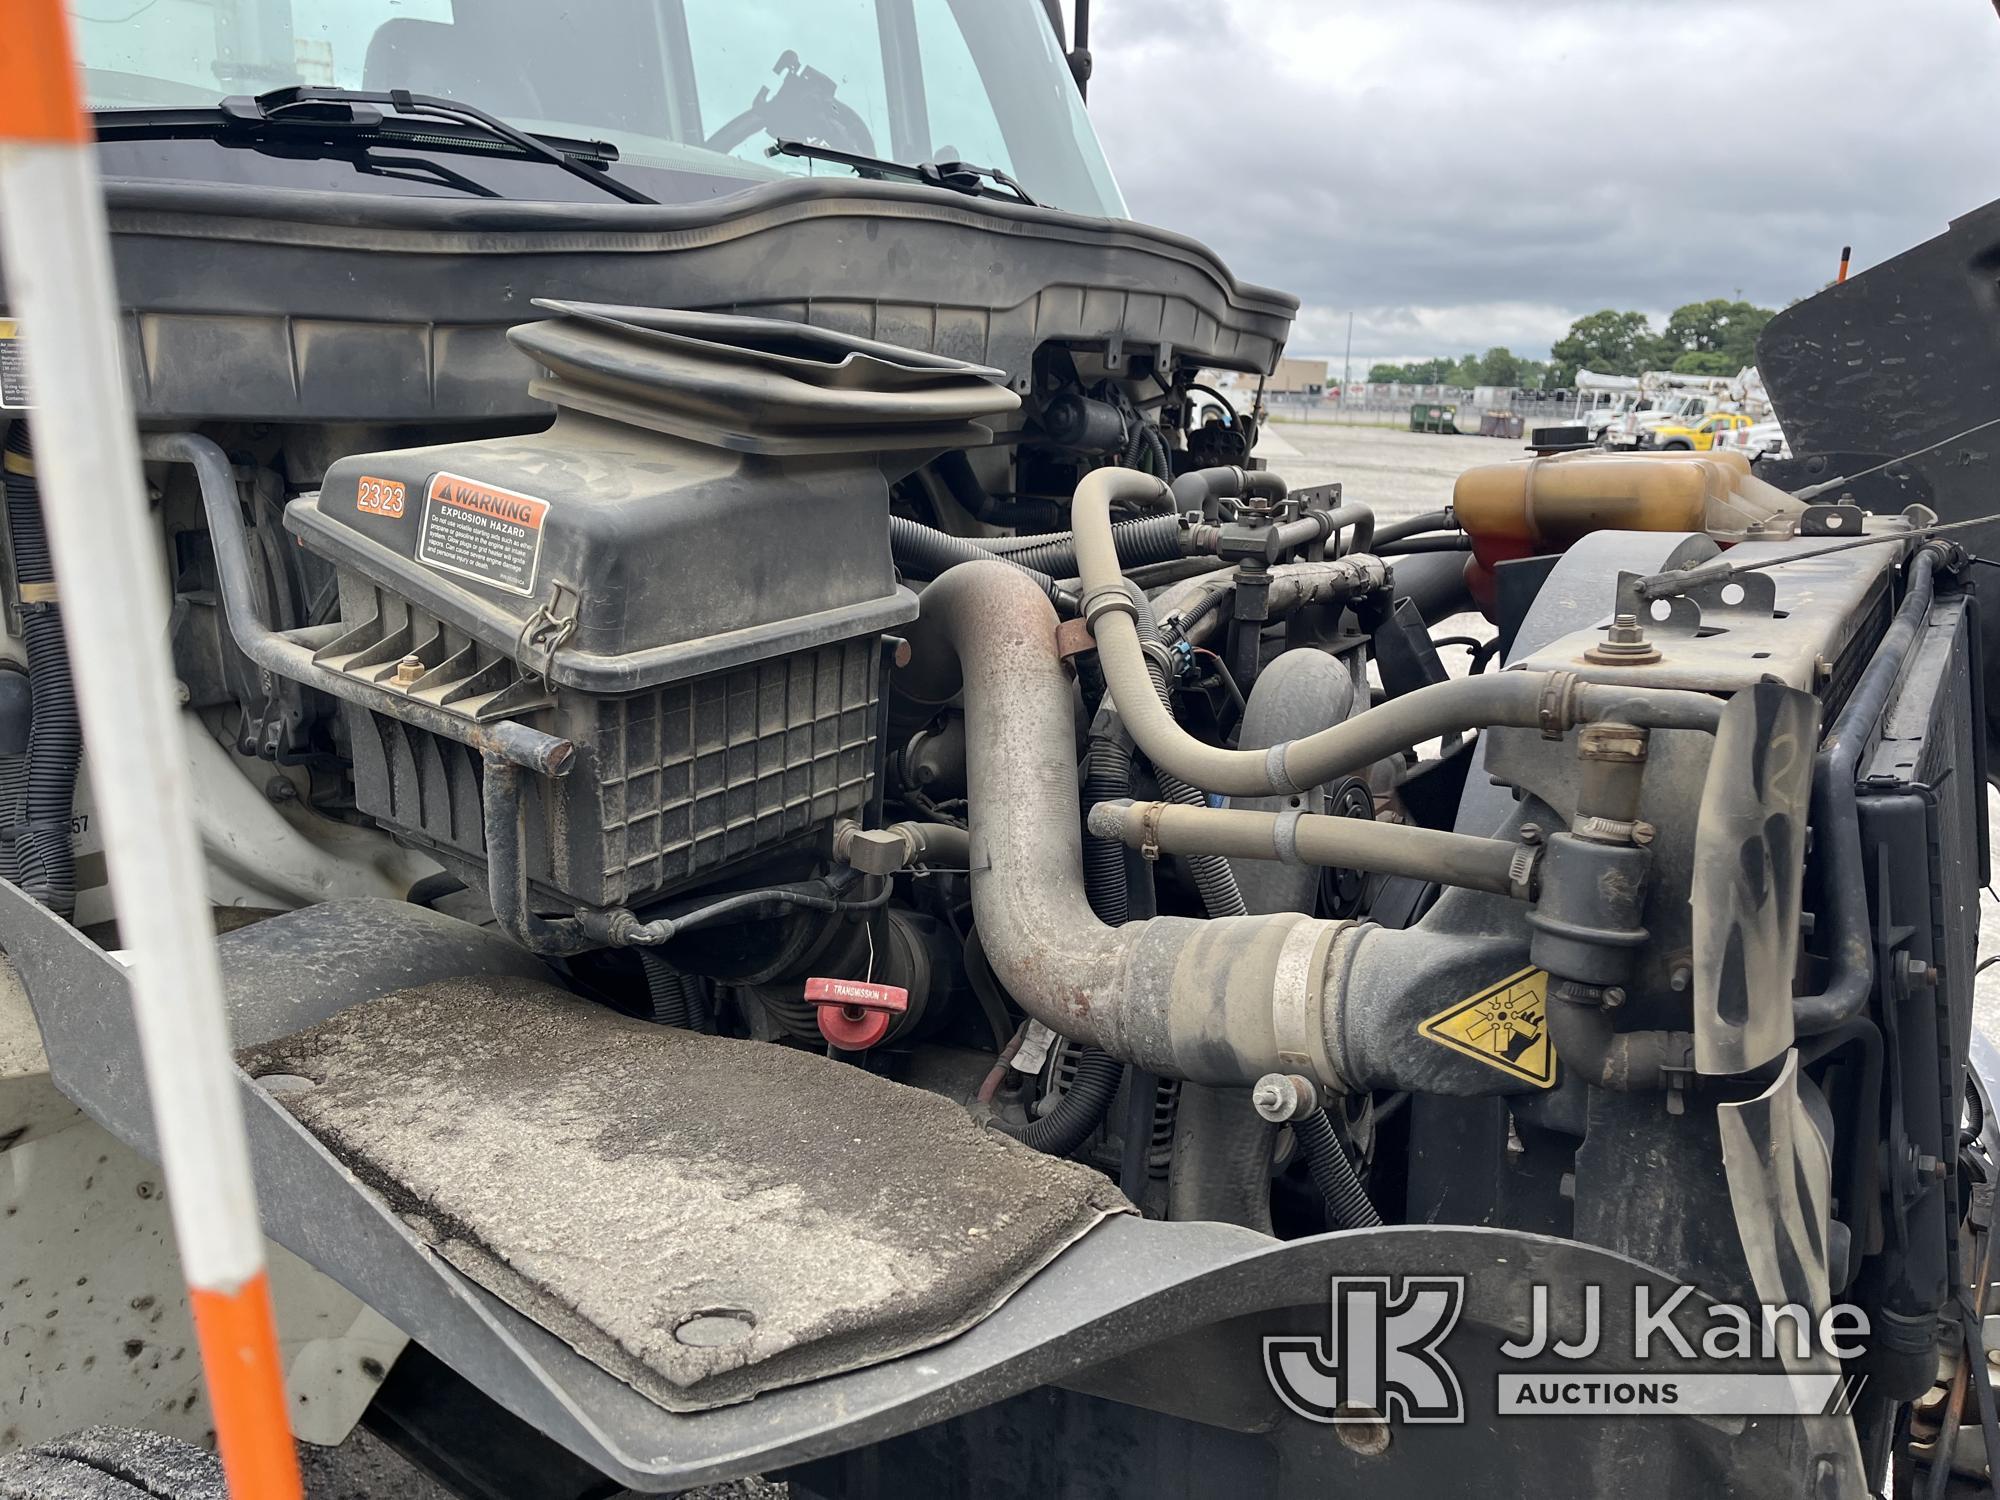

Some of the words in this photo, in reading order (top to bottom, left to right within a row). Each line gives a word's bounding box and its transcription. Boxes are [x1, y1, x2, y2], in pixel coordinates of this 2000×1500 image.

[359, 481, 404, 513] 2323
[455, 486, 532, 523] WARNING
[440, 505, 487, 527] EXPLOSION
[489, 520, 525, 538] HAZARD
[833, 984, 880, 1000] TRANSMISSION
